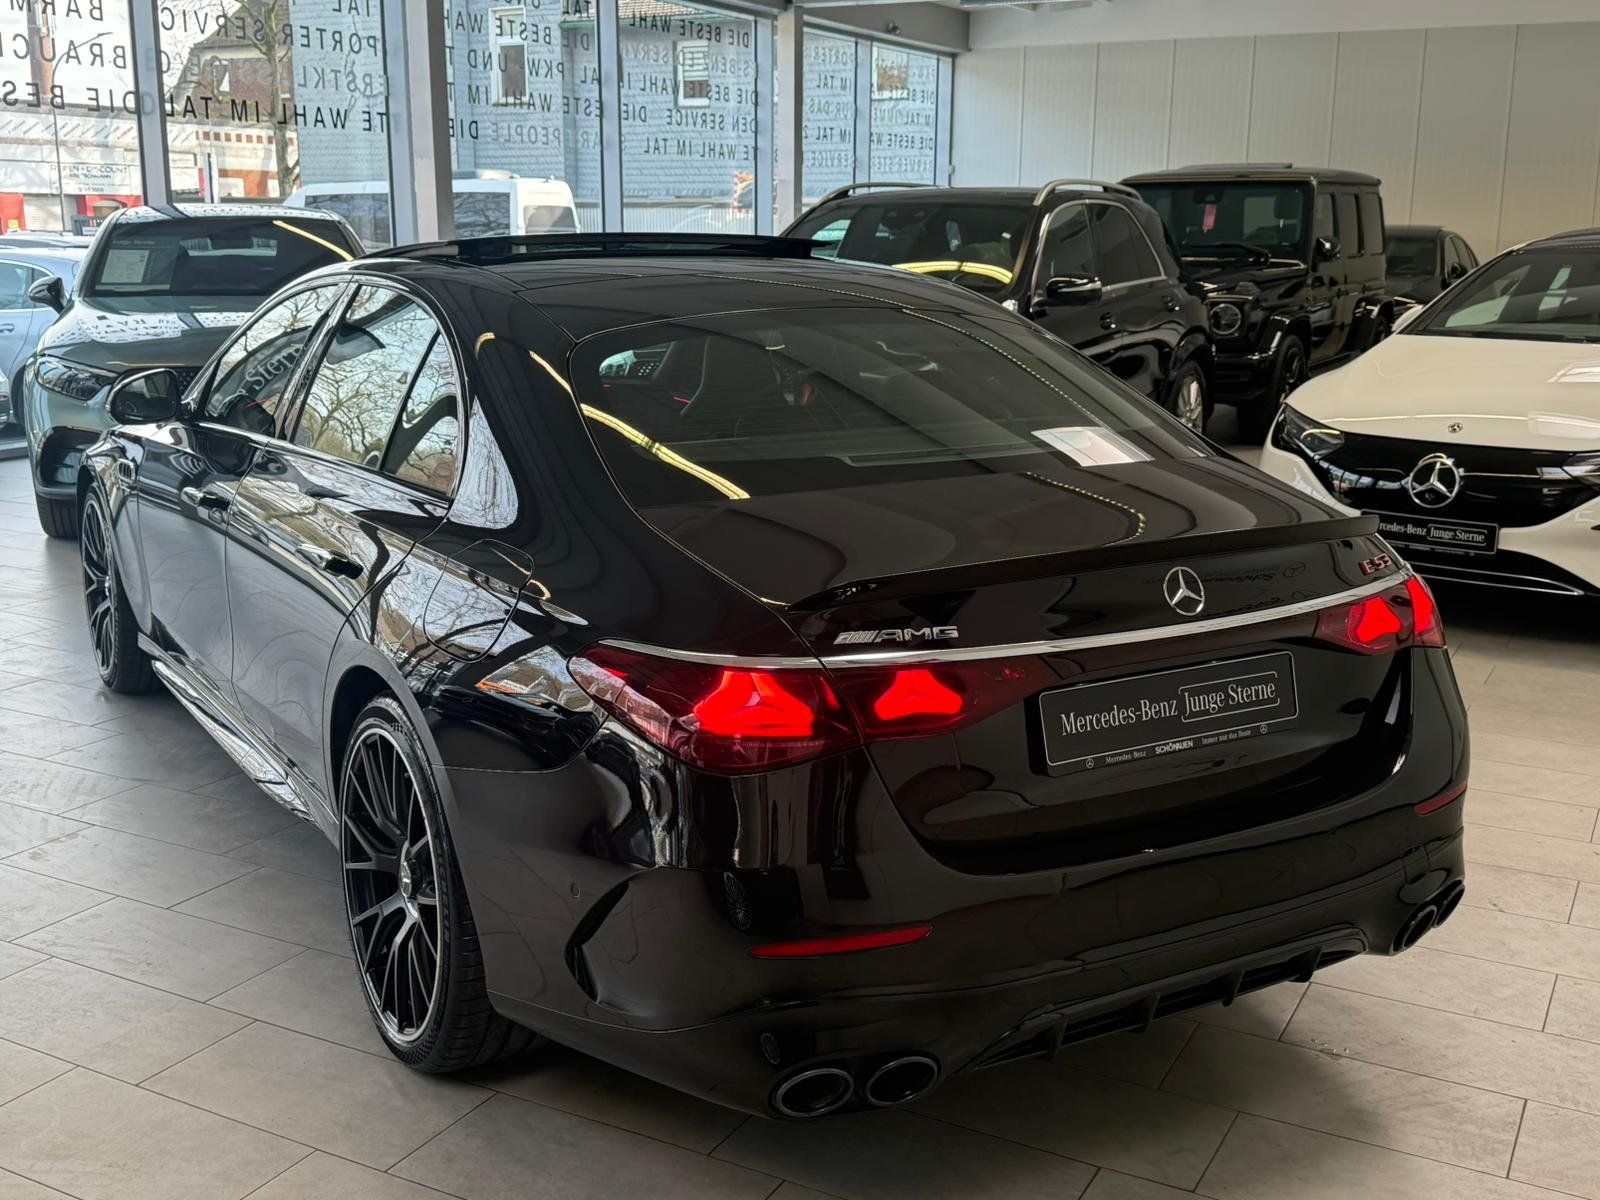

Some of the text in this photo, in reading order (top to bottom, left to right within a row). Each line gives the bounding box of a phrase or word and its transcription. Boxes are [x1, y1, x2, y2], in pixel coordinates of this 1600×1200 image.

[1429, 530, 1455, 540] Junge
[1455, 530, 1486, 543] Sterne
[874, 626, 959, 644] AMG
[1061, 682, 1276, 736] Mercedes-Benz Junge Sterne
